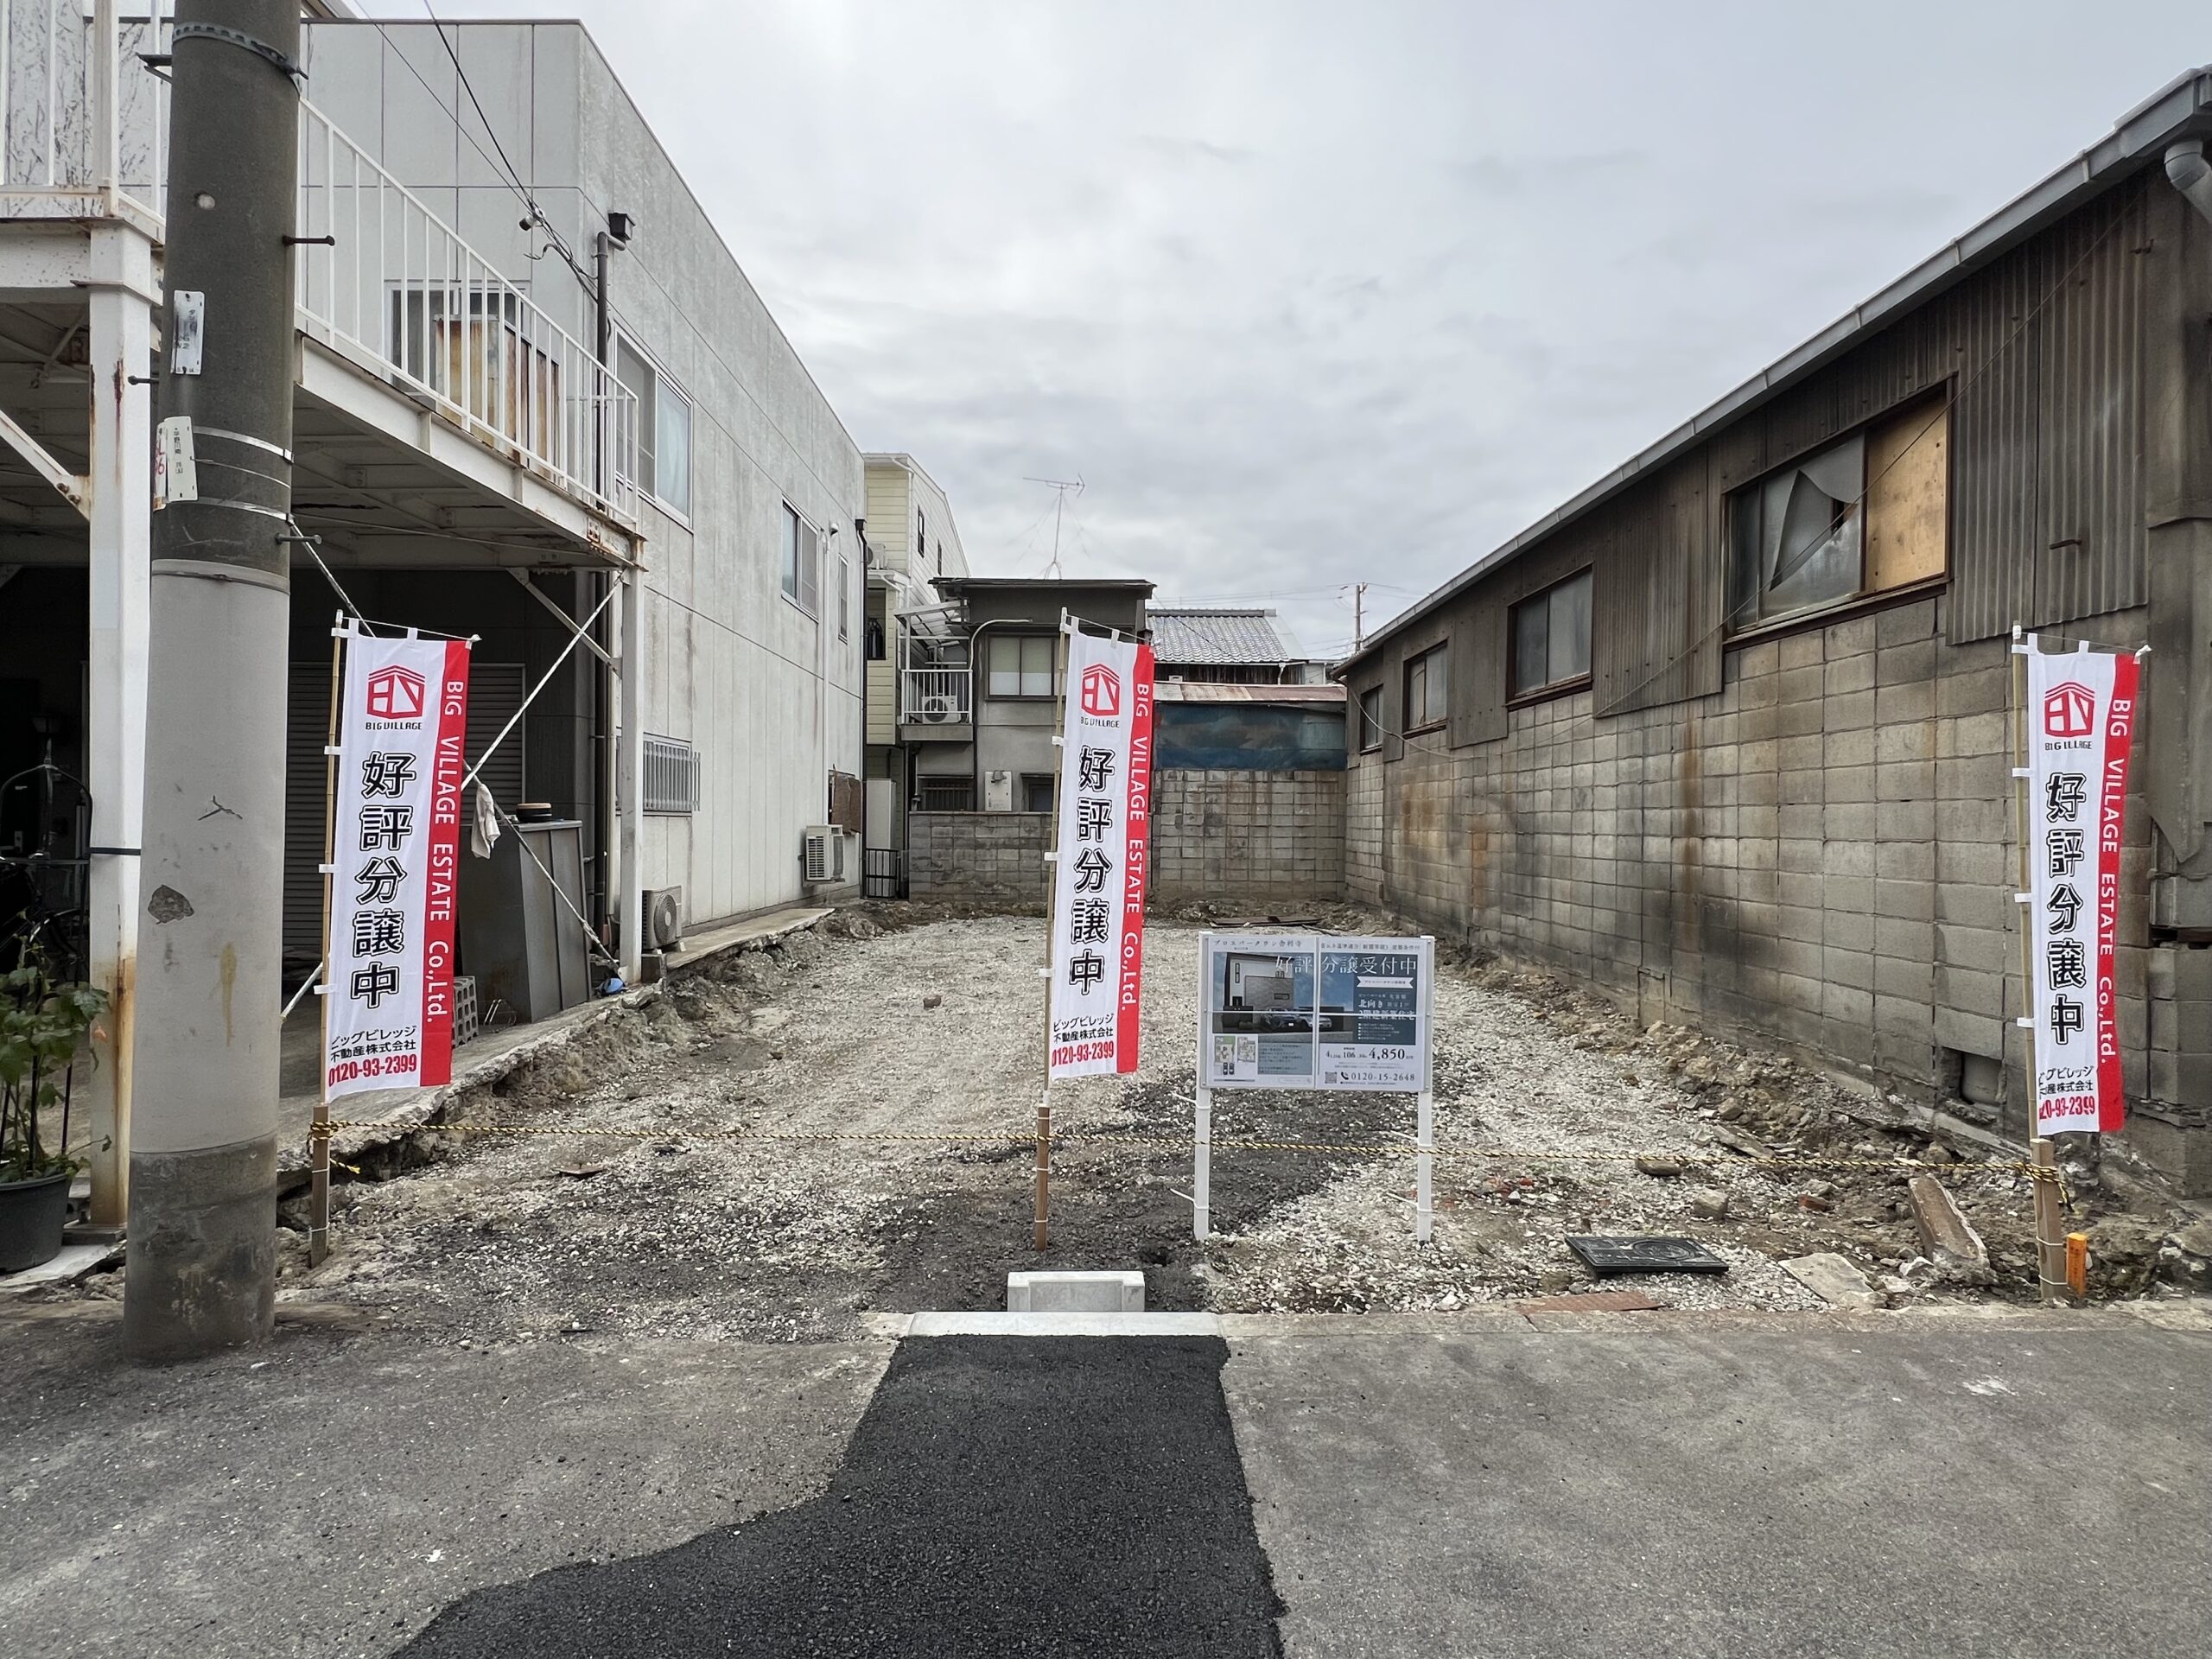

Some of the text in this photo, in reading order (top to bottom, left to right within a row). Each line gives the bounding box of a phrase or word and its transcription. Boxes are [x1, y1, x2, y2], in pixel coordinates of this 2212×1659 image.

[2063, 740, 2093, 750] ILLAGE
[426, 681, 464, 1023] BIG VILLAGE ESTATE Co.,Ltd.
[1121, 683, 1149, 1011] BIG VILLAGE ESTATE Co.,Ltd.
[350, 751, 416, 1009] 好評分譲中
[1069, 745, 1116, 996] 好評分譲中
[2098, 698, 2131, 1064] BIG VILLAGE ESTATE Co.,Ltd.
[1052, 1013, 1115, 1033] ビッグビレッジ
[1053, 1026, 1114, 1044] 不動産株式会社
[330, 1039, 416, 1064] 不動産株式会社
[1051, 1039, 1115, 1068] 0120-93-2399
[1368, 1046, 1406, 1061] 4,850
[328, 1053, 417, 1088] 0120-93-2399
[1351, 1071, 1415, 1082] 0120-15-2648
